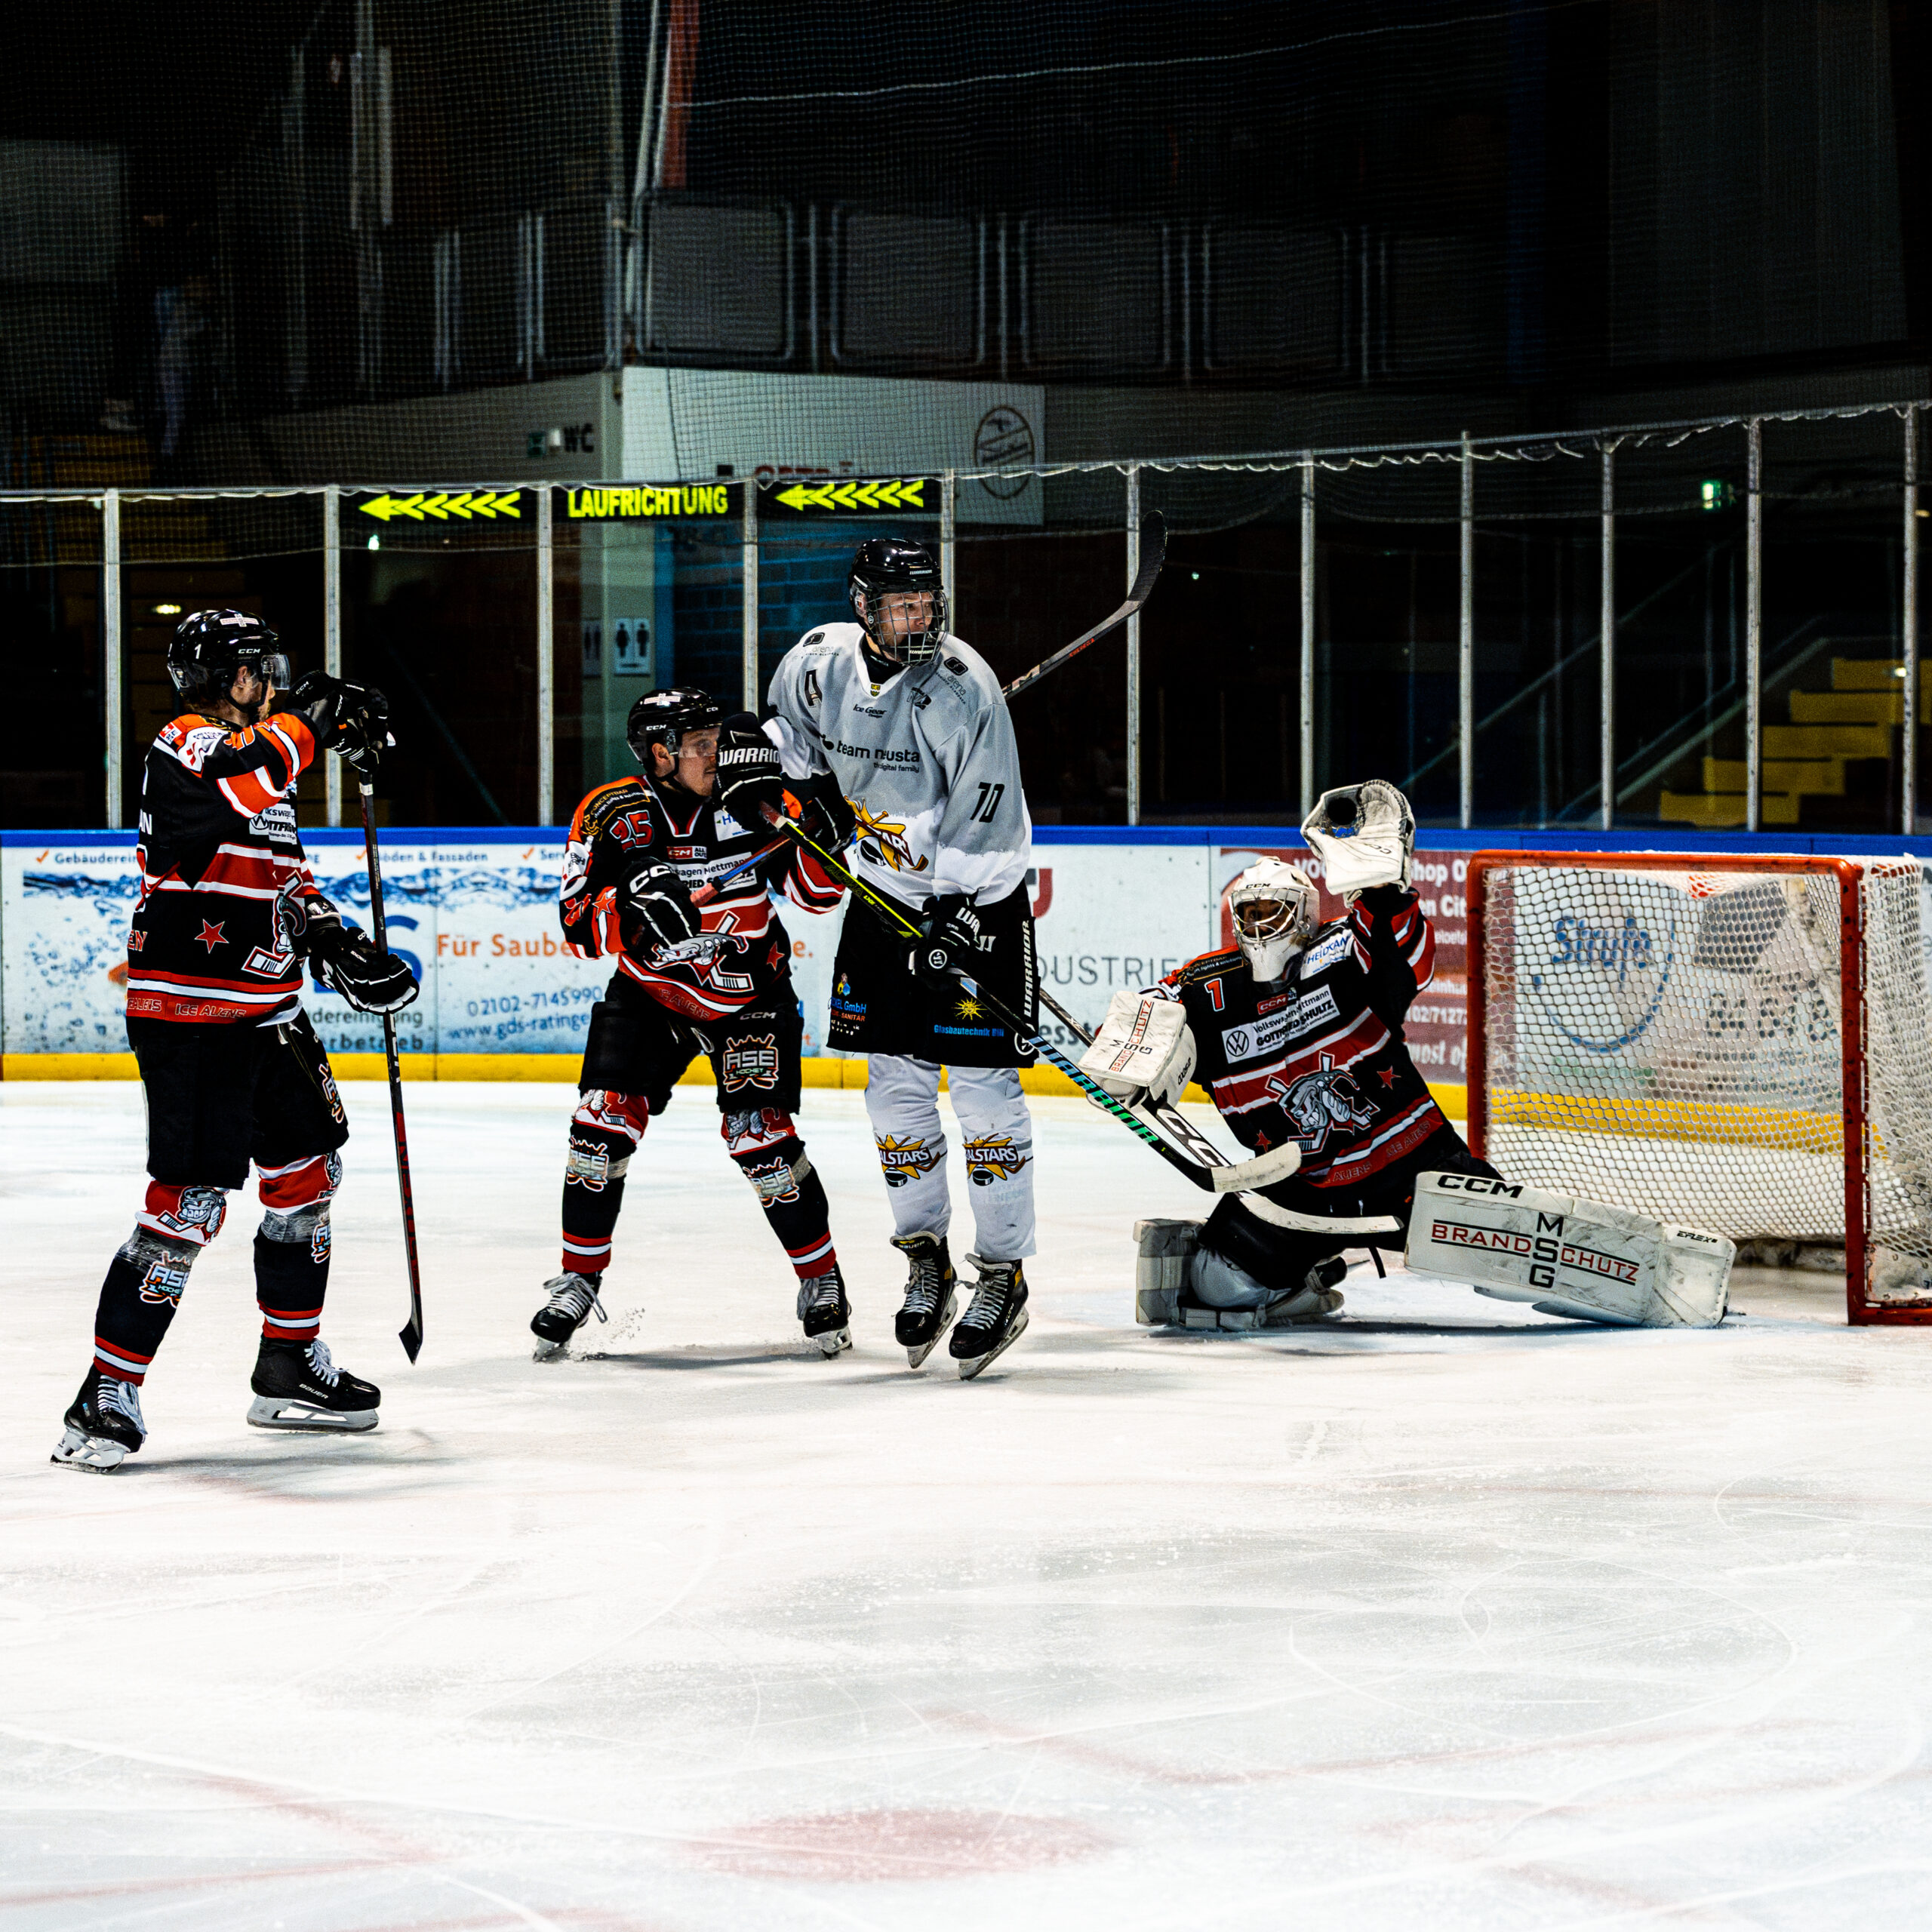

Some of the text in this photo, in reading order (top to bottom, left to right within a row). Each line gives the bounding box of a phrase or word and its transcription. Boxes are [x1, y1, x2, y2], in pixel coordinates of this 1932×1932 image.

[564, 423, 594, 453] WC
[568, 485, 728, 518] LAUFRICHTUNG
[836, 740, 870, 759] team
[432, 849, 489, 863] Fassaden
[436, 934, 481, 958] Für
[1023, 919, 1034, 1018] WARRIOR
[467, 985, 603, 1017] 02102-7145990
[1204, 977, 1226, 1012] 1
[1260, 996, 1287, 1011] CCM
[739, 1011, 777, 1020] CCM
[843, 1000, 867, 1014] GmbH
[726, 1050, 775, 1070] ASE
[1437, 1174, 1524, 1199] CCM
[298, 1383, 330, 1400] BAUER
